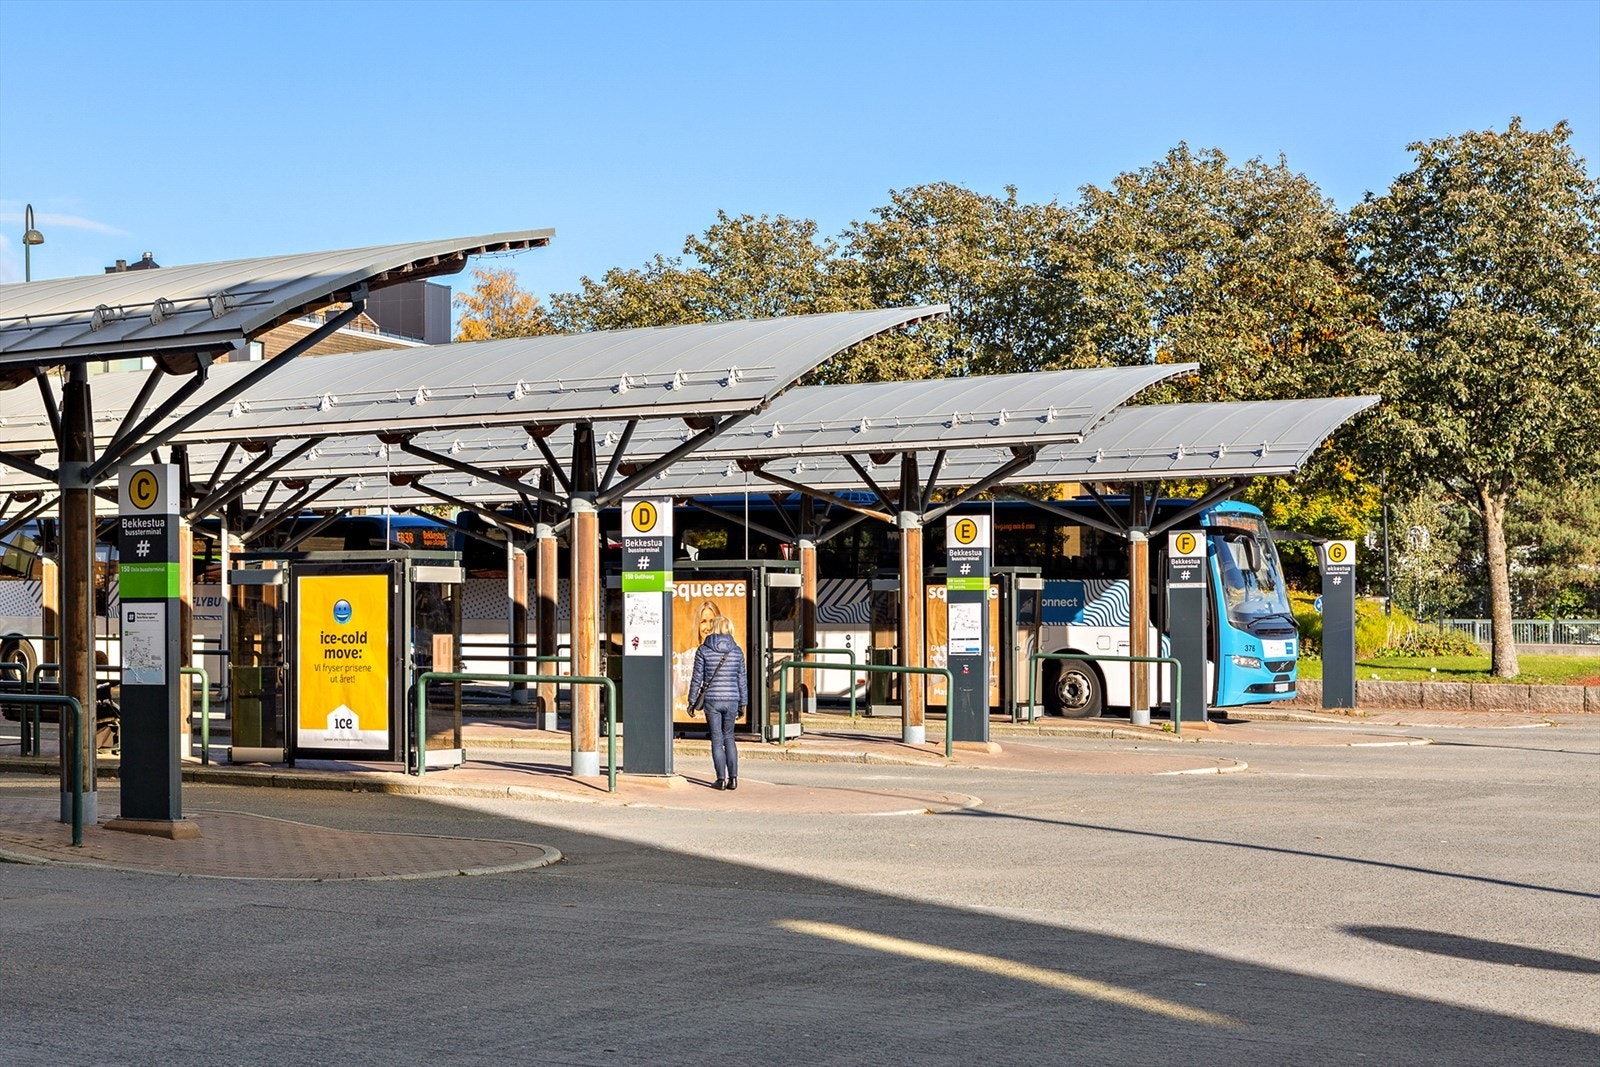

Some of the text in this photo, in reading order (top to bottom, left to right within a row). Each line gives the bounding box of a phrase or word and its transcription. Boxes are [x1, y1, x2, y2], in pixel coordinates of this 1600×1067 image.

[138, 478, 150, 500] C
[640, 508, 650, 525] D
[121, 518, 165, 529] Bekkestua
[124, 528, 162, 536] bussterminal
[961, 524, 970, 538] E
[625, 539, 663, 548] Bekkestua
[1181, 537, 1190, 550] F
[1333, 547, 1341, 558] G
[671, 582, 746, 602] squeeze
[1041, 597, 1078, 607] onnect
[320, 631, 368, 644] ice-cold
[324, 648, 363, 659] move:
[313, 663, 372, 675] Vi fryser prisene
[339, 674, 356, 683] året!
[334, 717, 353, 730] ice
